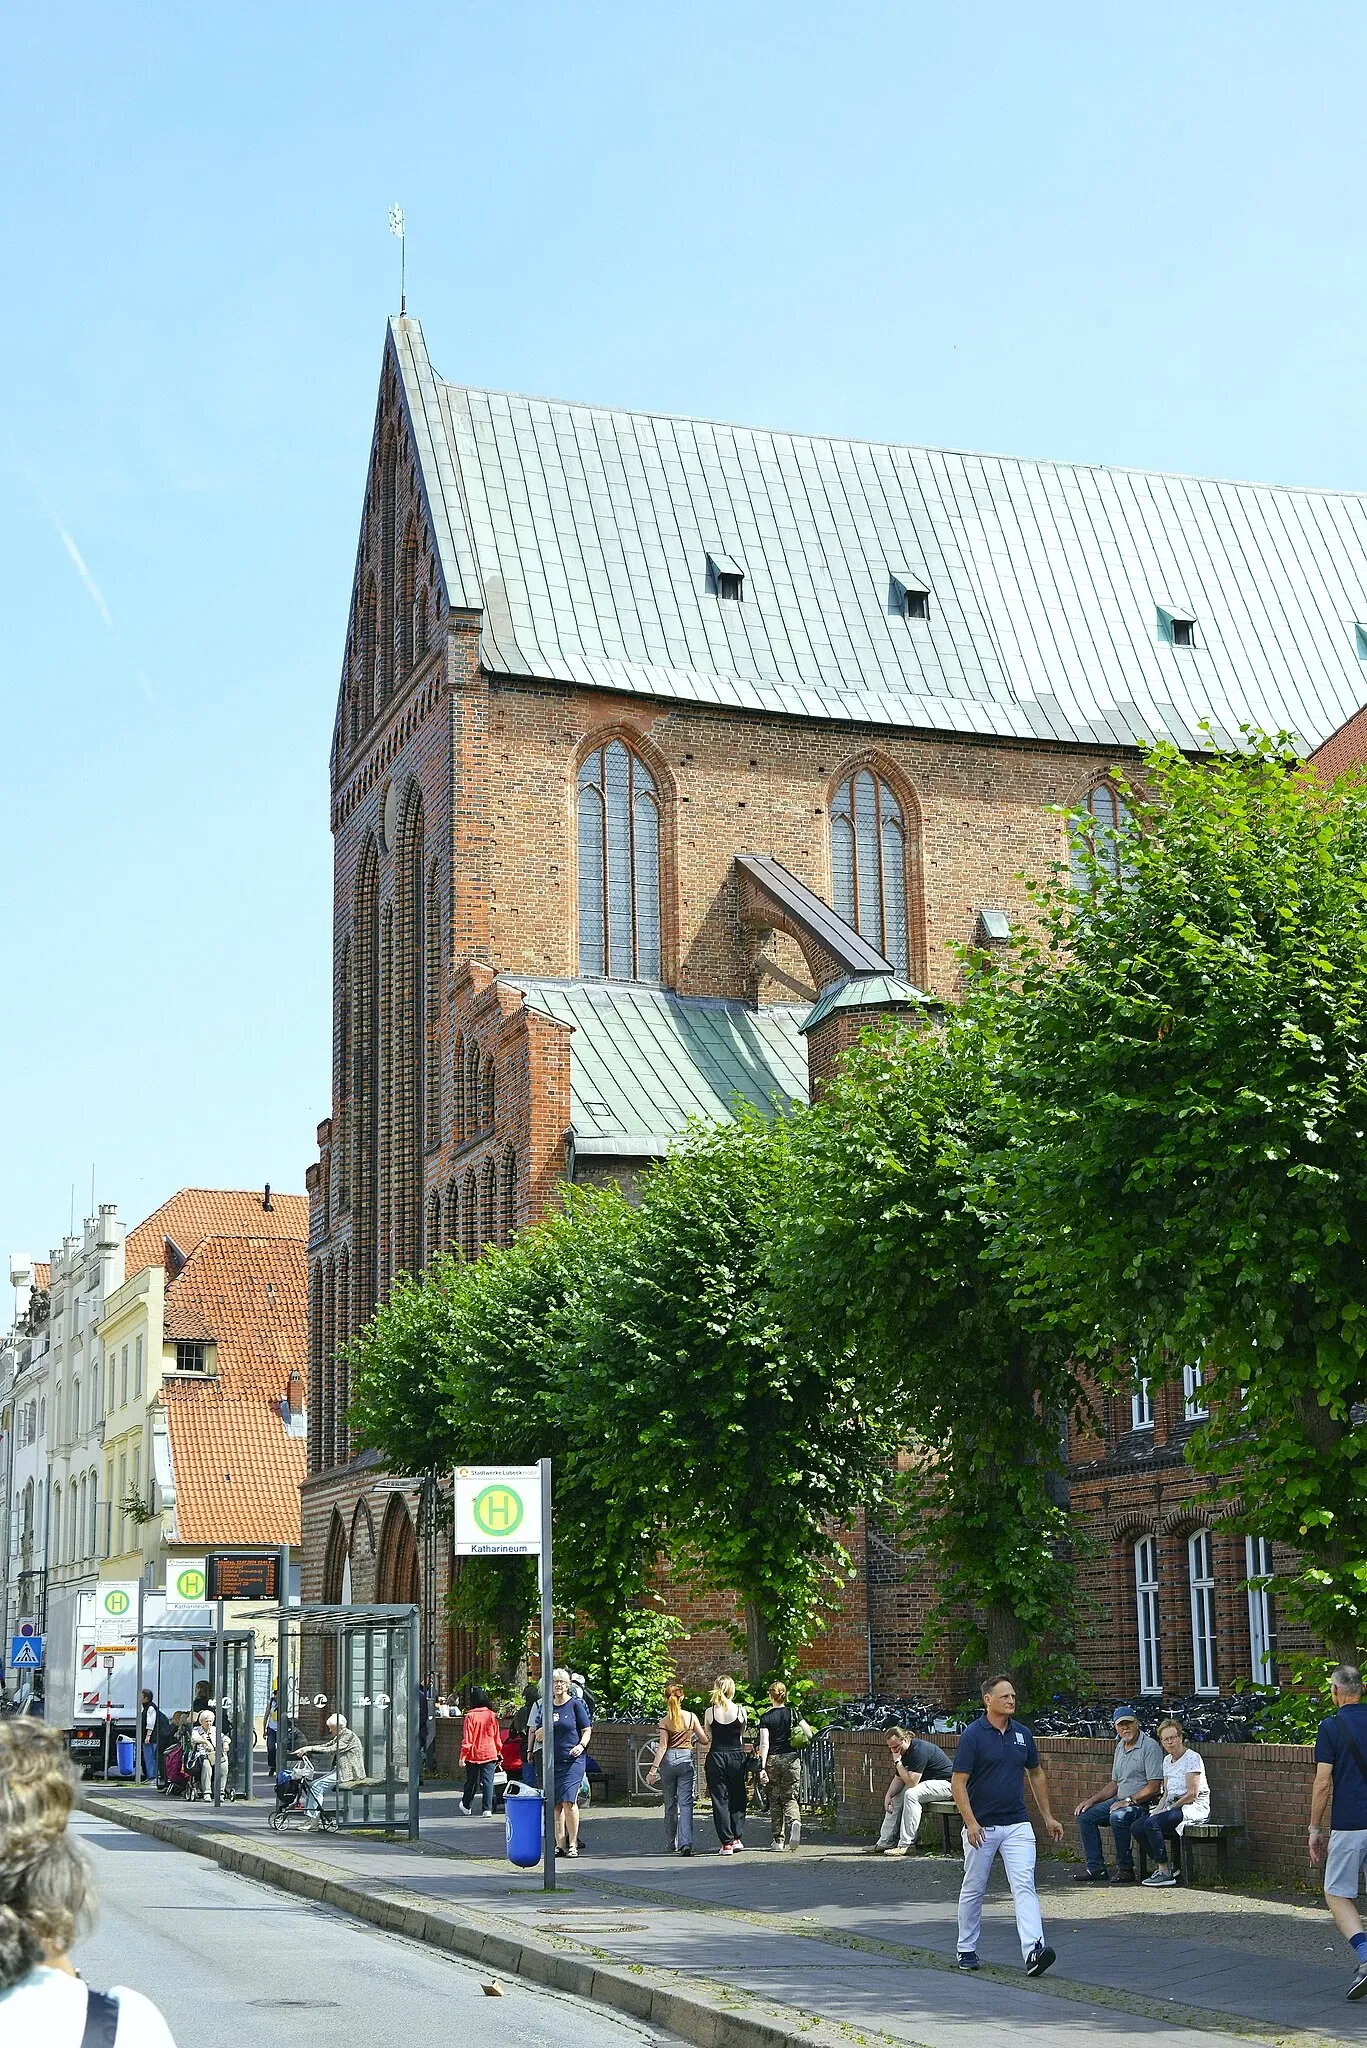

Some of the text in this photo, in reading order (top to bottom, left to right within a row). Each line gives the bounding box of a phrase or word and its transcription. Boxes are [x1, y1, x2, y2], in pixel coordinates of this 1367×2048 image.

[488, 1496, 508, 1525] H
[471, 1544, 528, 1553] Katharineum
[186, 1576, 198, 1593] H
[111, 1595, 123, 1610] H
